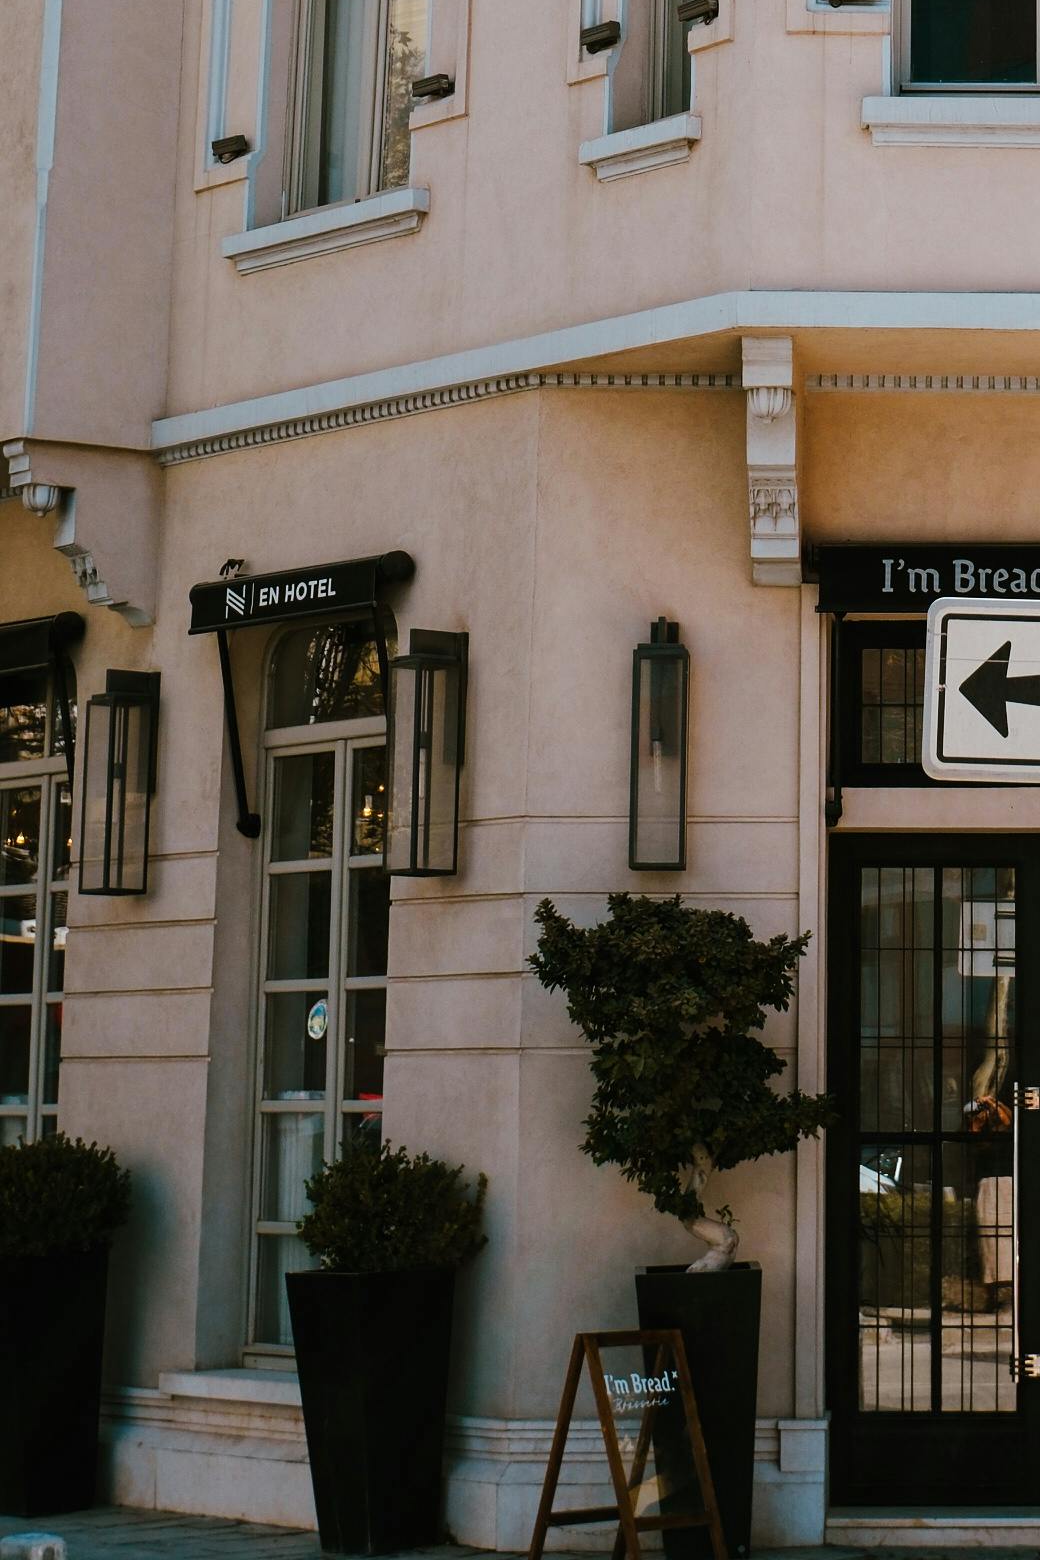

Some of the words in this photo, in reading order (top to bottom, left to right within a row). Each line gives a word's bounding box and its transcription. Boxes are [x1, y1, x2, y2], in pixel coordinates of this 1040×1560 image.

[881, 558, 941, 593] I'm
[258, 585, 280, 607] EN
[284, 577, 336, 603] HOTEL
[603, 1374, 630, 1396] I'm
[630, 1370, 676, 1394] Bread.
